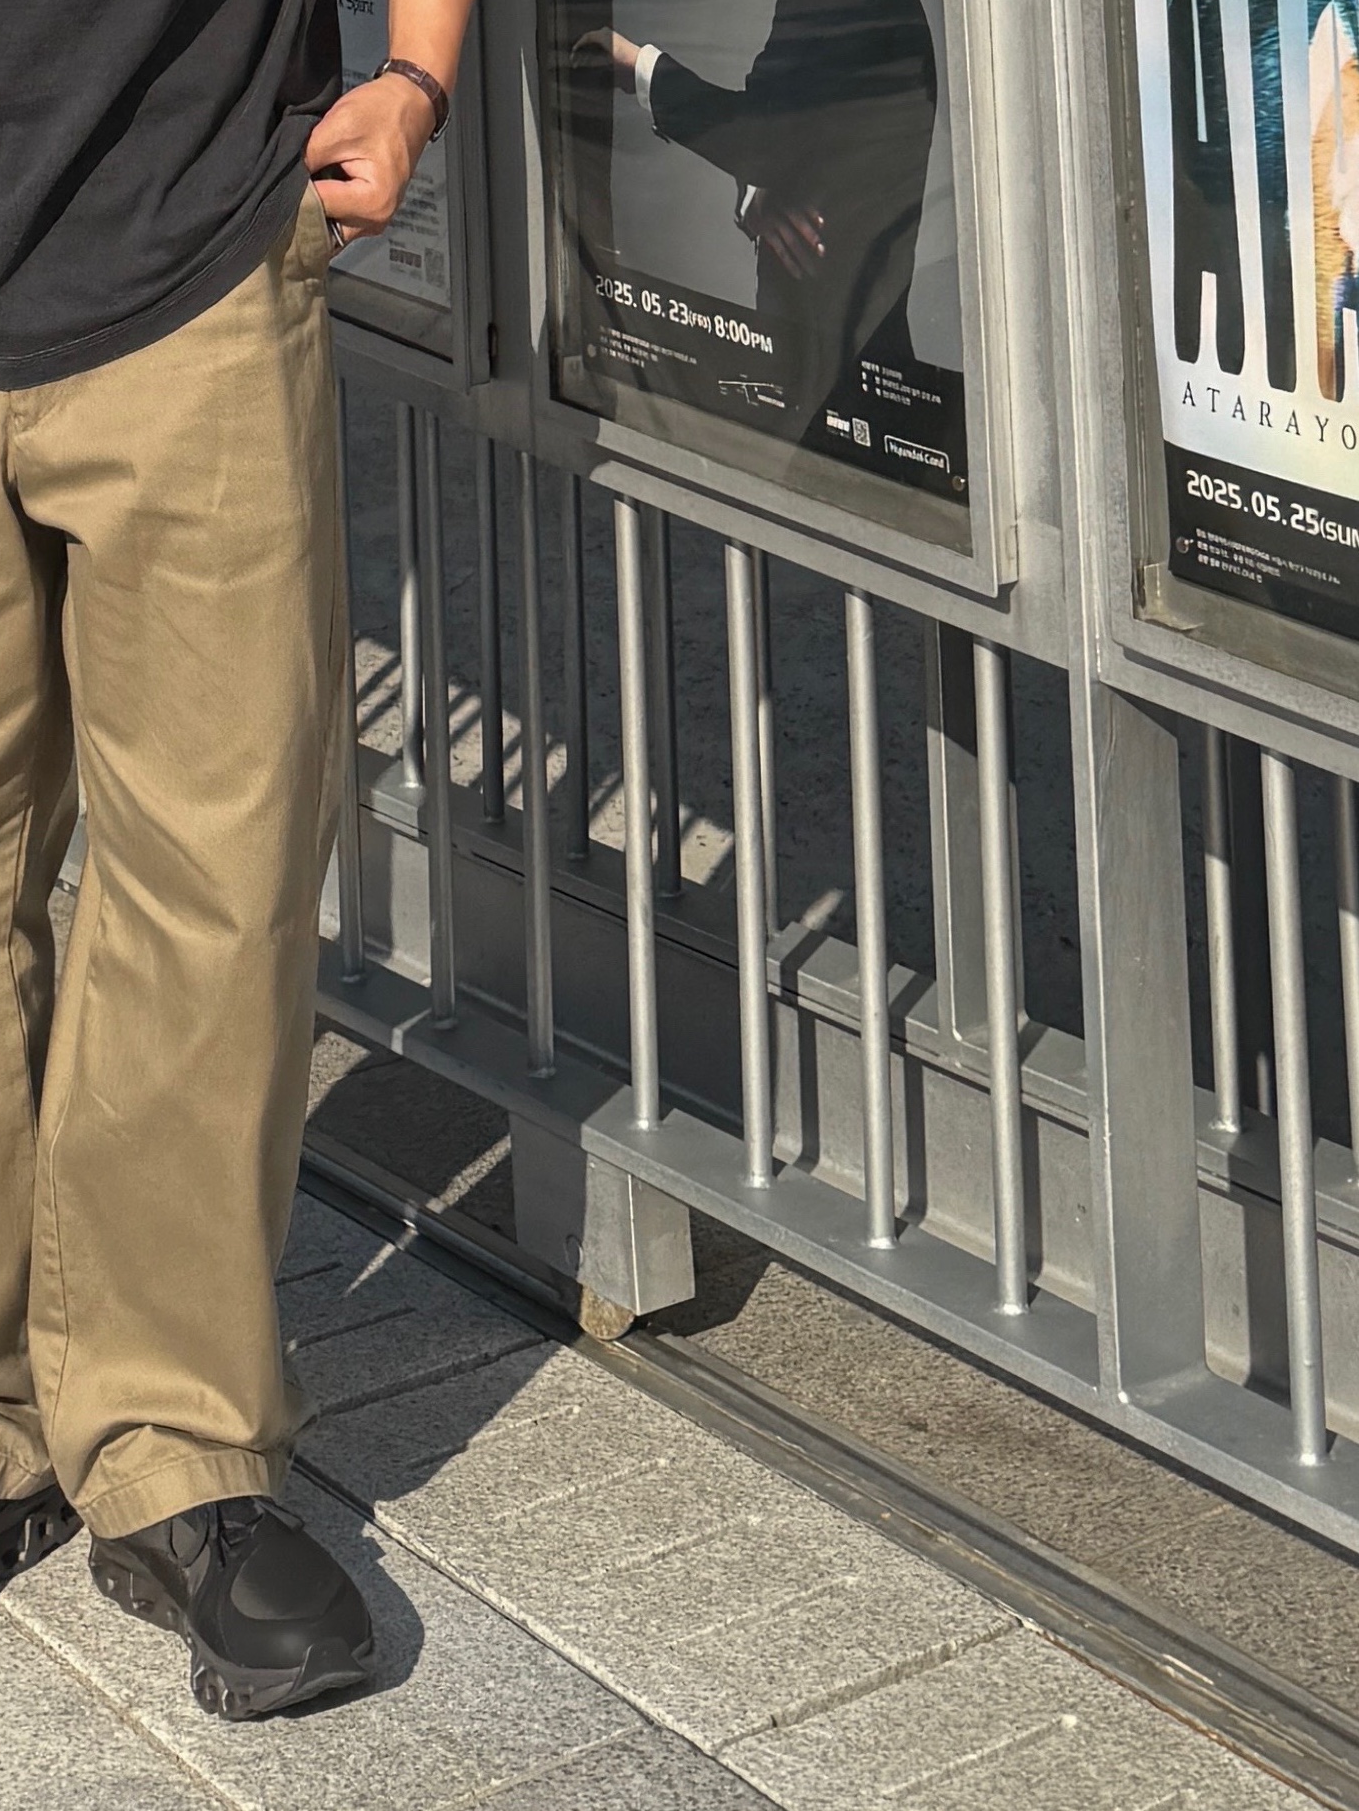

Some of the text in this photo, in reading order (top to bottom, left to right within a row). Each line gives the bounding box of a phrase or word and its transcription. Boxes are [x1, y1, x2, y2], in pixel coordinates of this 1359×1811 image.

[596, 275, 637, 308] 2025.
[641, 290, 665, 318] 05.
[714, 315, 774, 354] 8:00PM
[1182, 381, 1357, 450] ATARAYO
